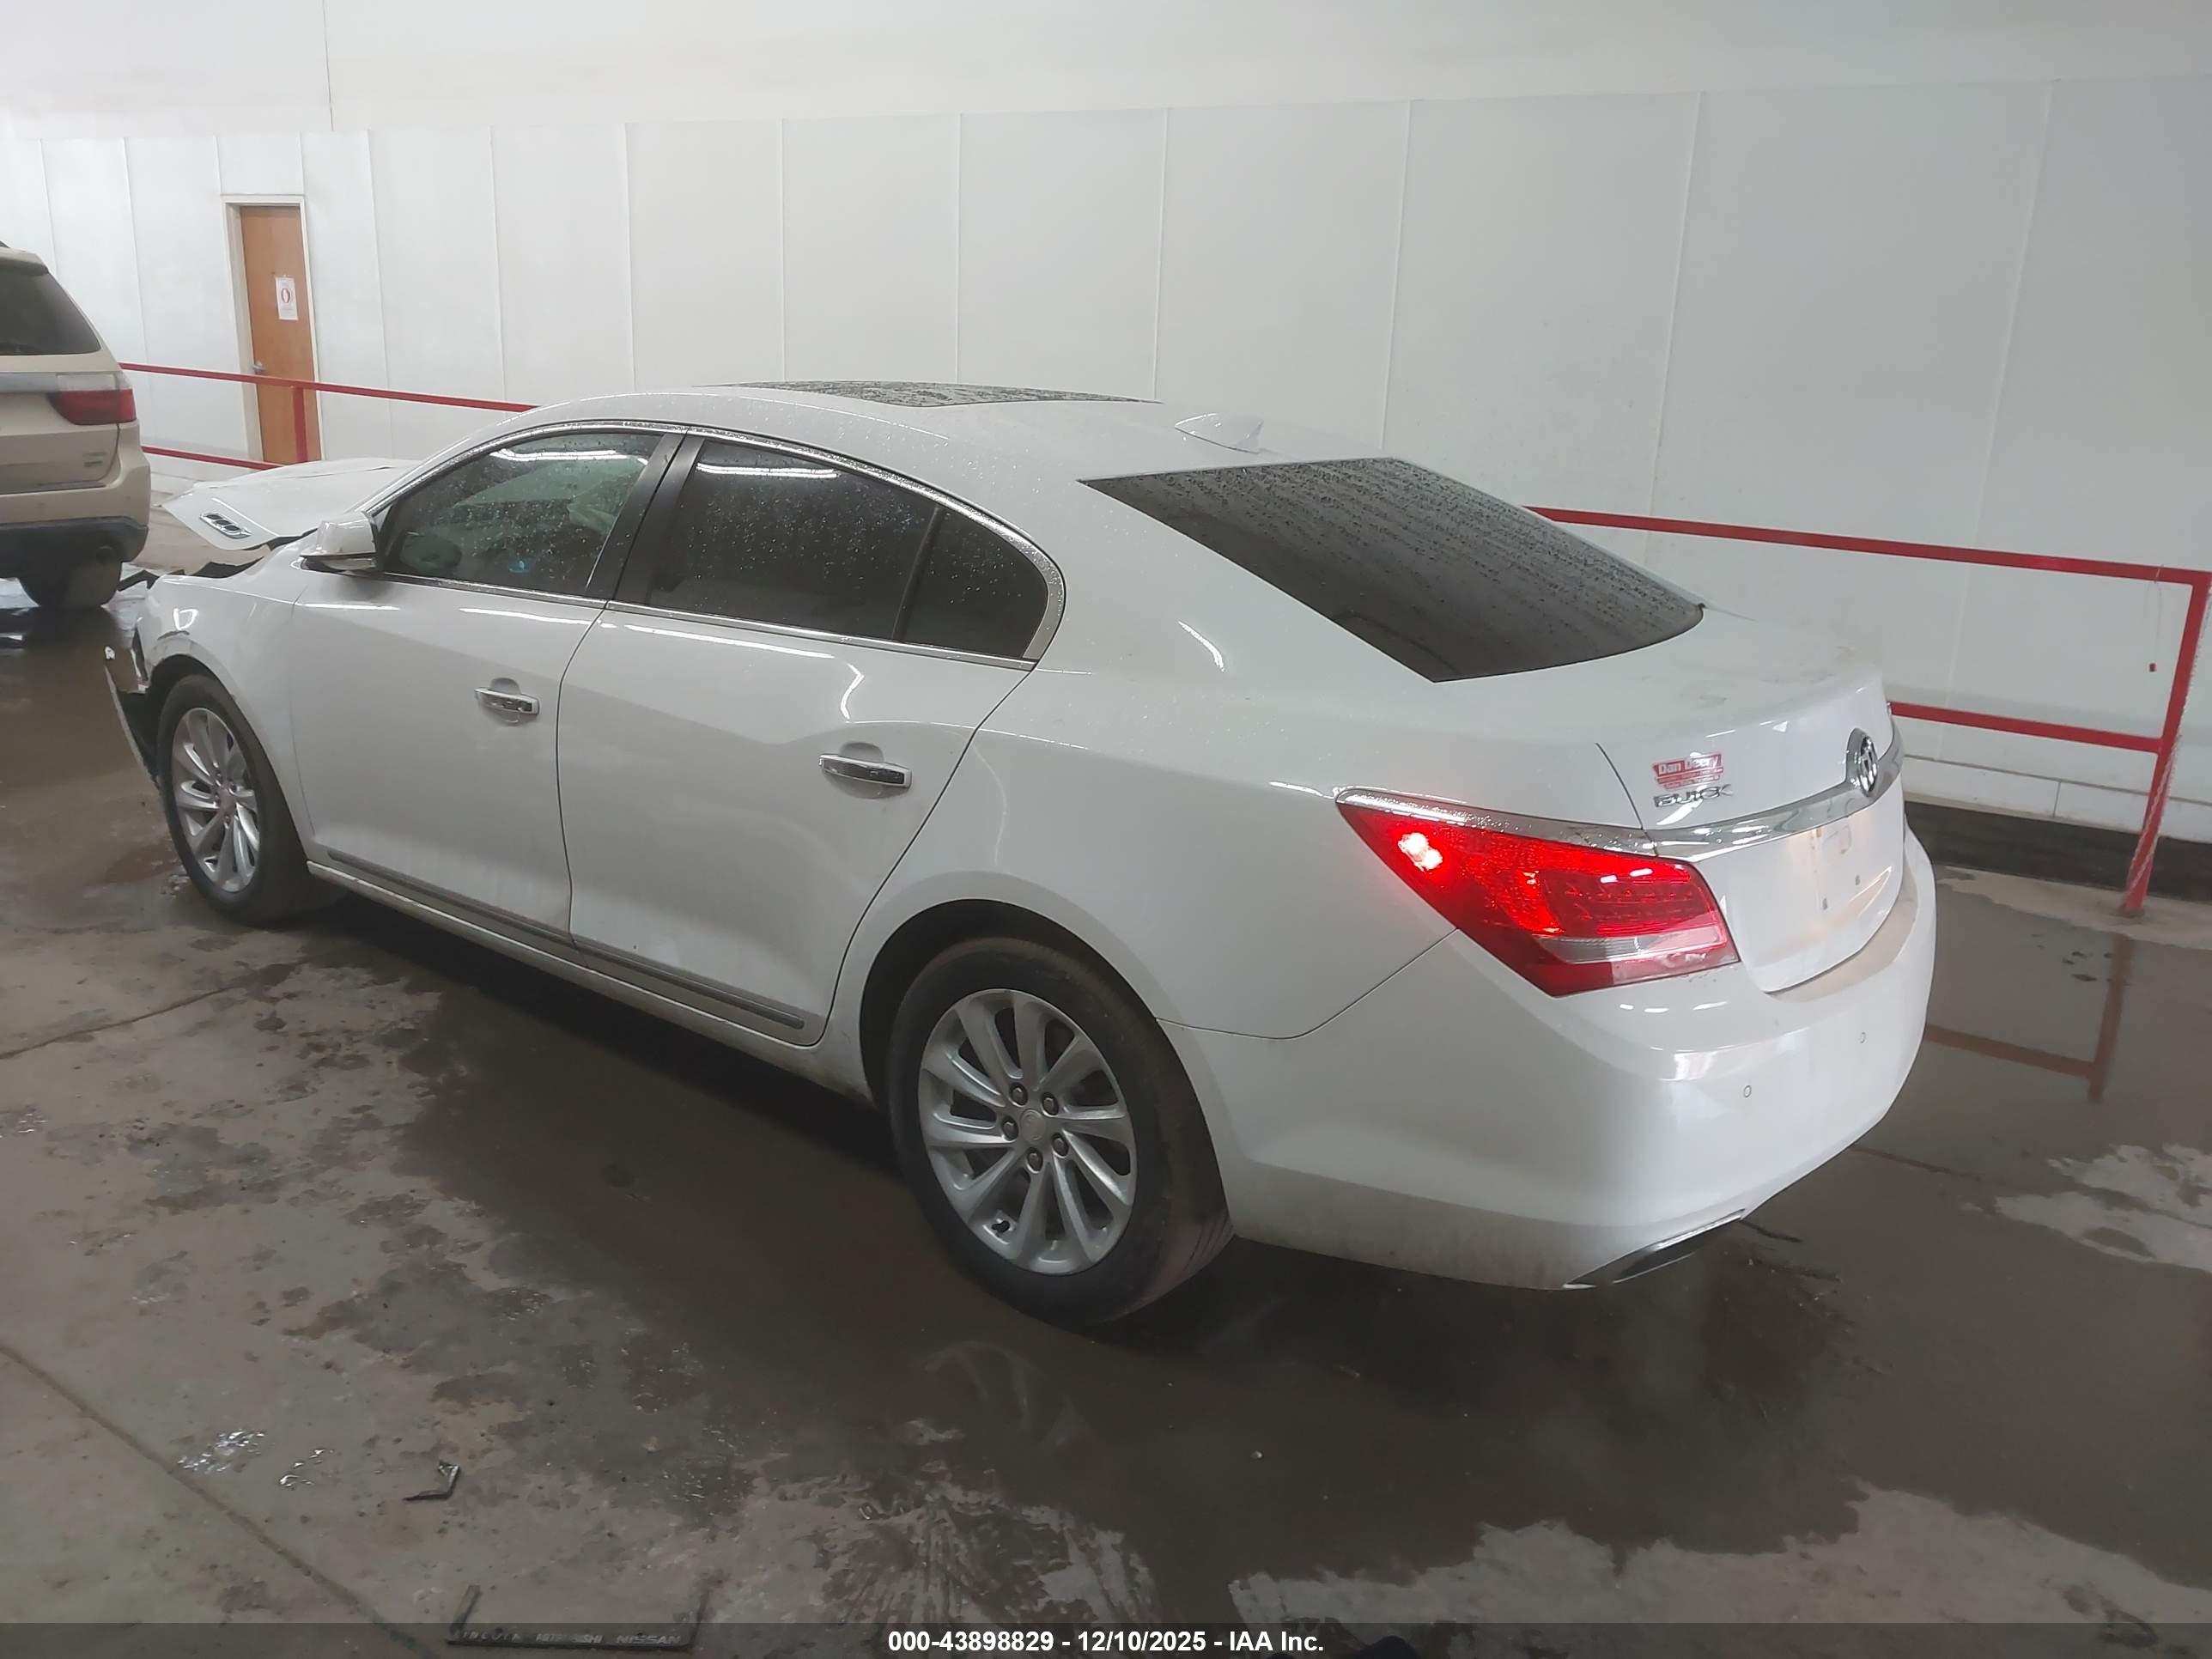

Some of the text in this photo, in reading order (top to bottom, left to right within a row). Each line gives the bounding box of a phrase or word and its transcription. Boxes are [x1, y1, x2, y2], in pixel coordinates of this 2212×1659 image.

[1658, 762, 1682, 775] Dan
[1653, 783, 1734, 807] BUICK
[616, 1634, 681, 1644] NISSAN
